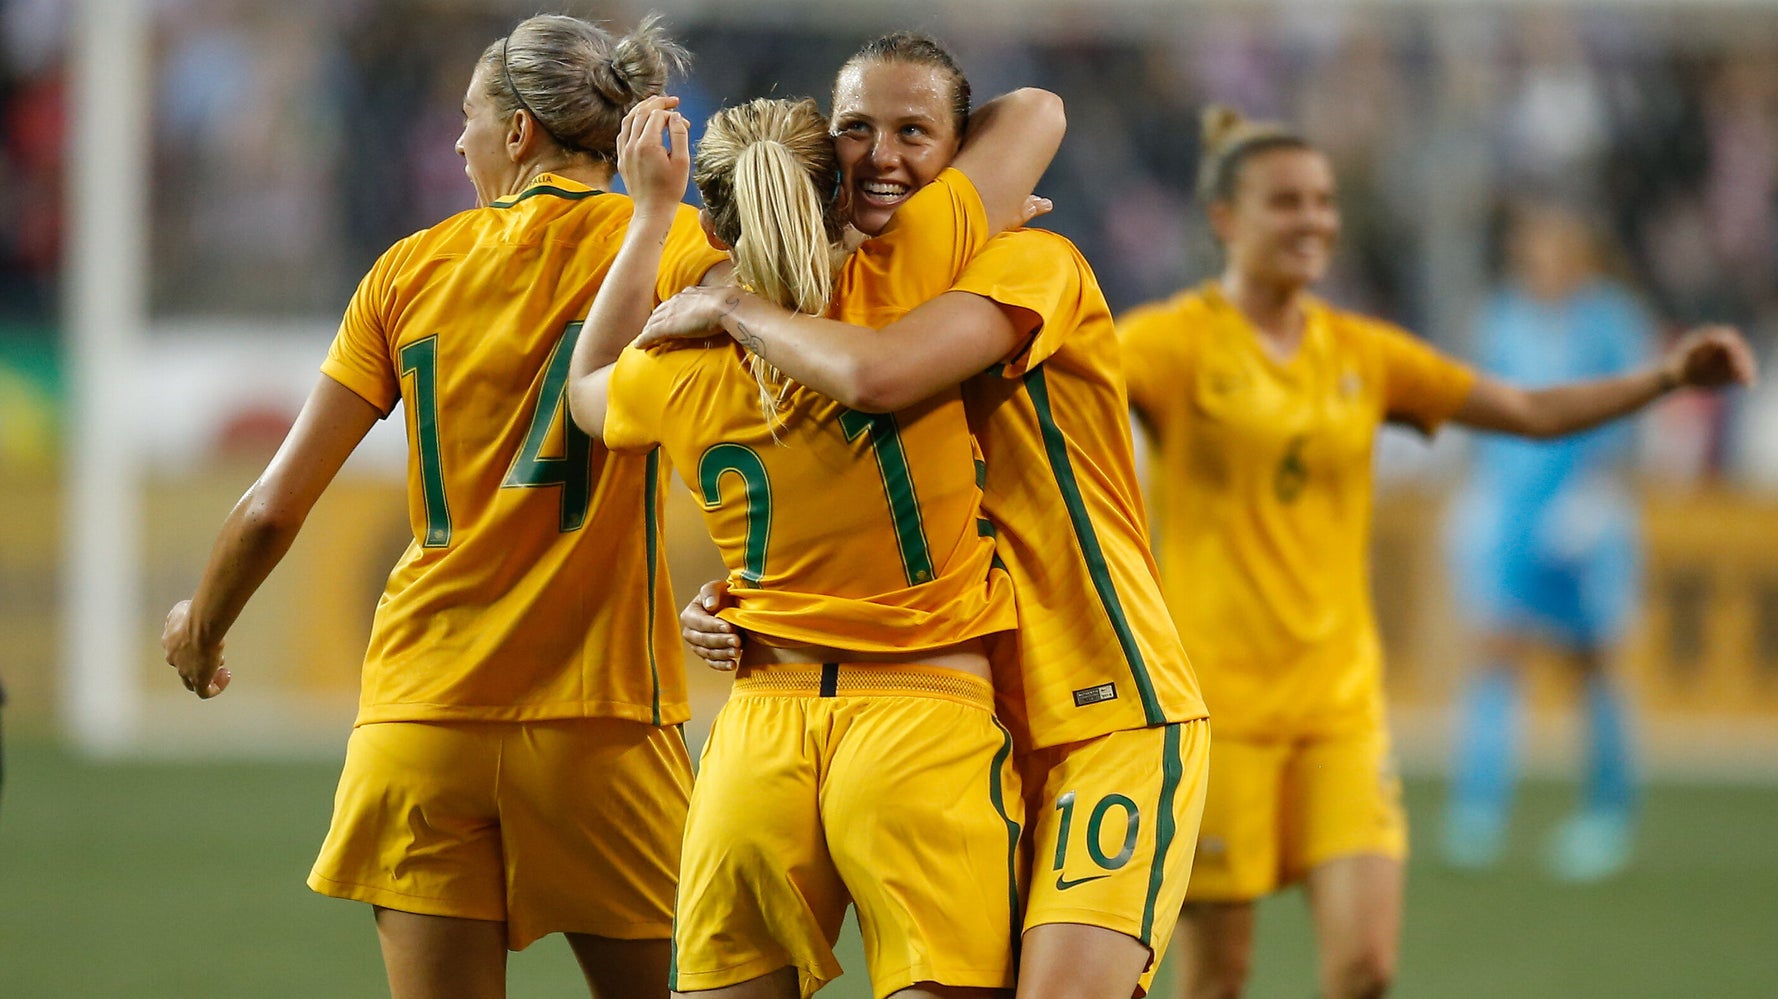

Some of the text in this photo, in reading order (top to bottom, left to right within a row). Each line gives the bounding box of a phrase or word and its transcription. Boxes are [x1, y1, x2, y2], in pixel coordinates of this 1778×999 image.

[531, 174, 553, 185] ALIA
[398, 321, 591, 548] 14
[697, 407, 936, 587] 21
[1053, 790, 1140, 871] 10
